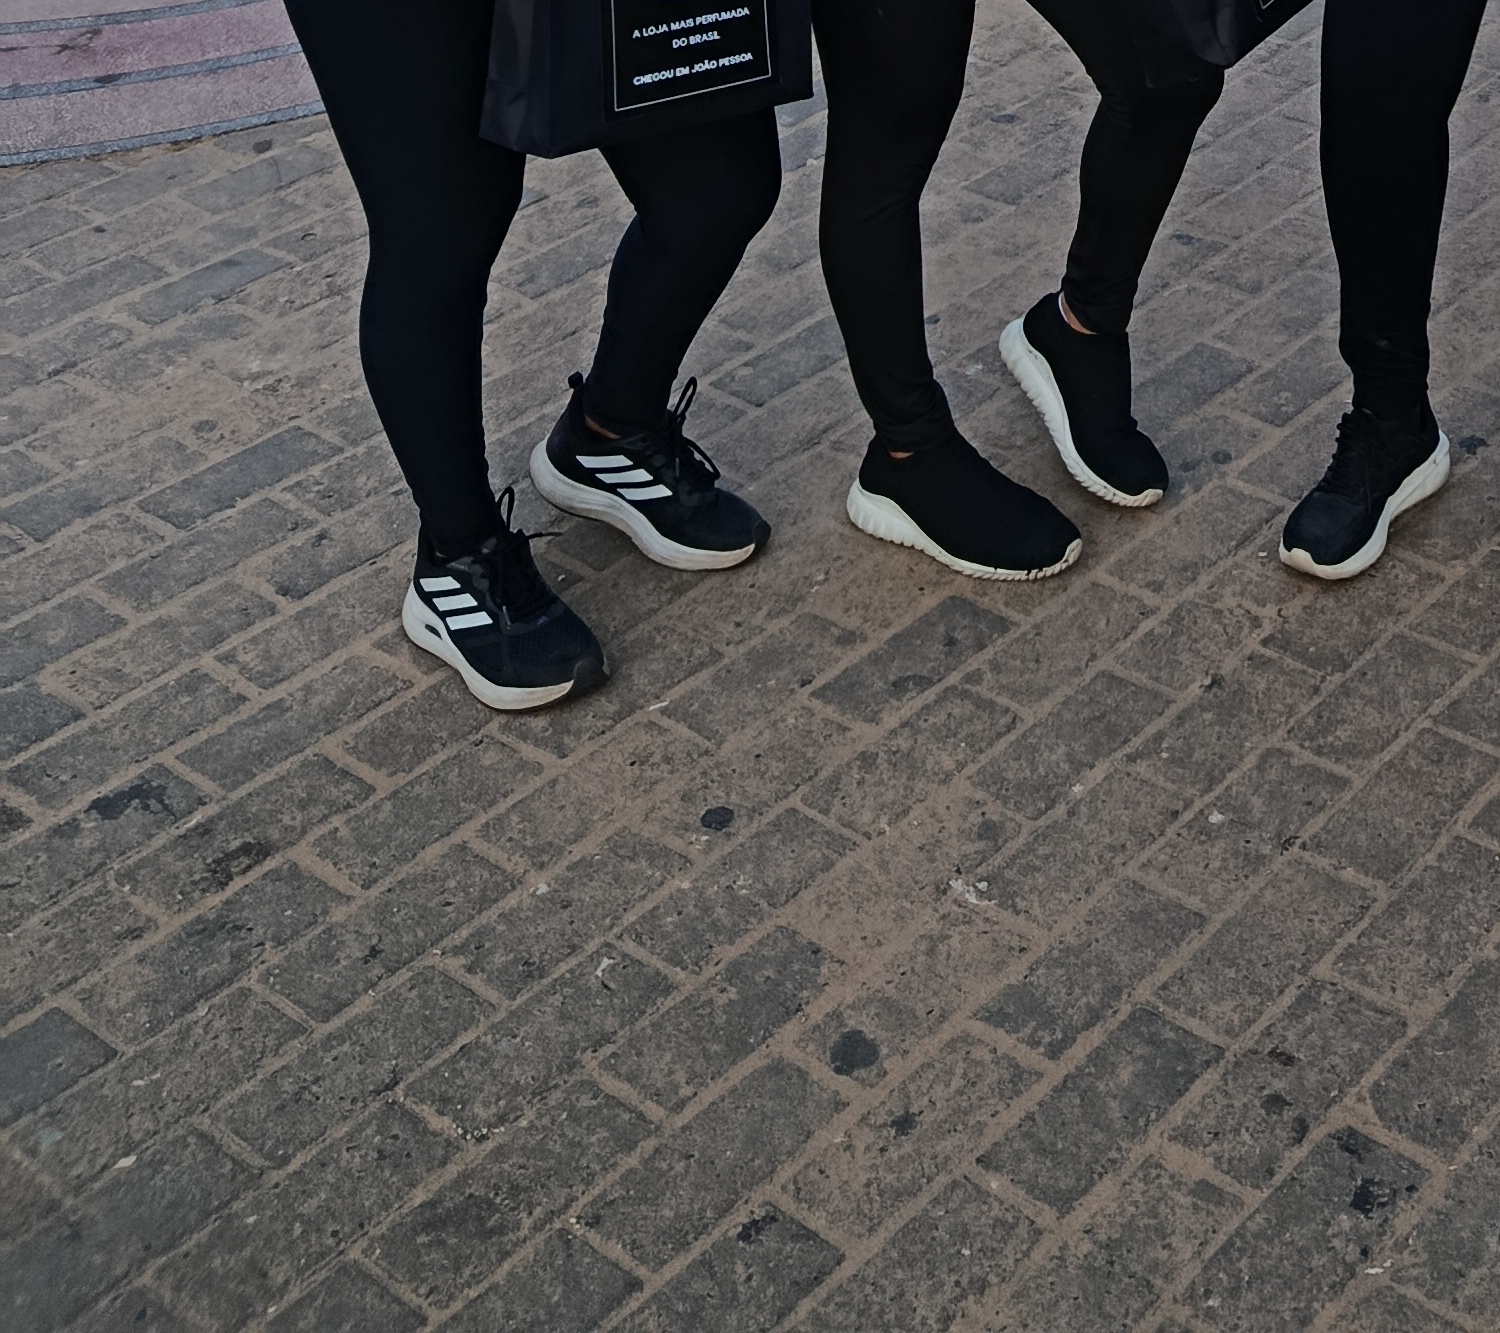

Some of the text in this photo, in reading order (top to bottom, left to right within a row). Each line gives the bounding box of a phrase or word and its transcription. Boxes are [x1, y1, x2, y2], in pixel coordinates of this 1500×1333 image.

[632, 6, 750, 39] A LOJA MAIS PERFUMADA
[672, 31, 721, 49] DO BRASIL
[633, 52, 753, 86] CHEGOU EM JOÃO PESSOA
